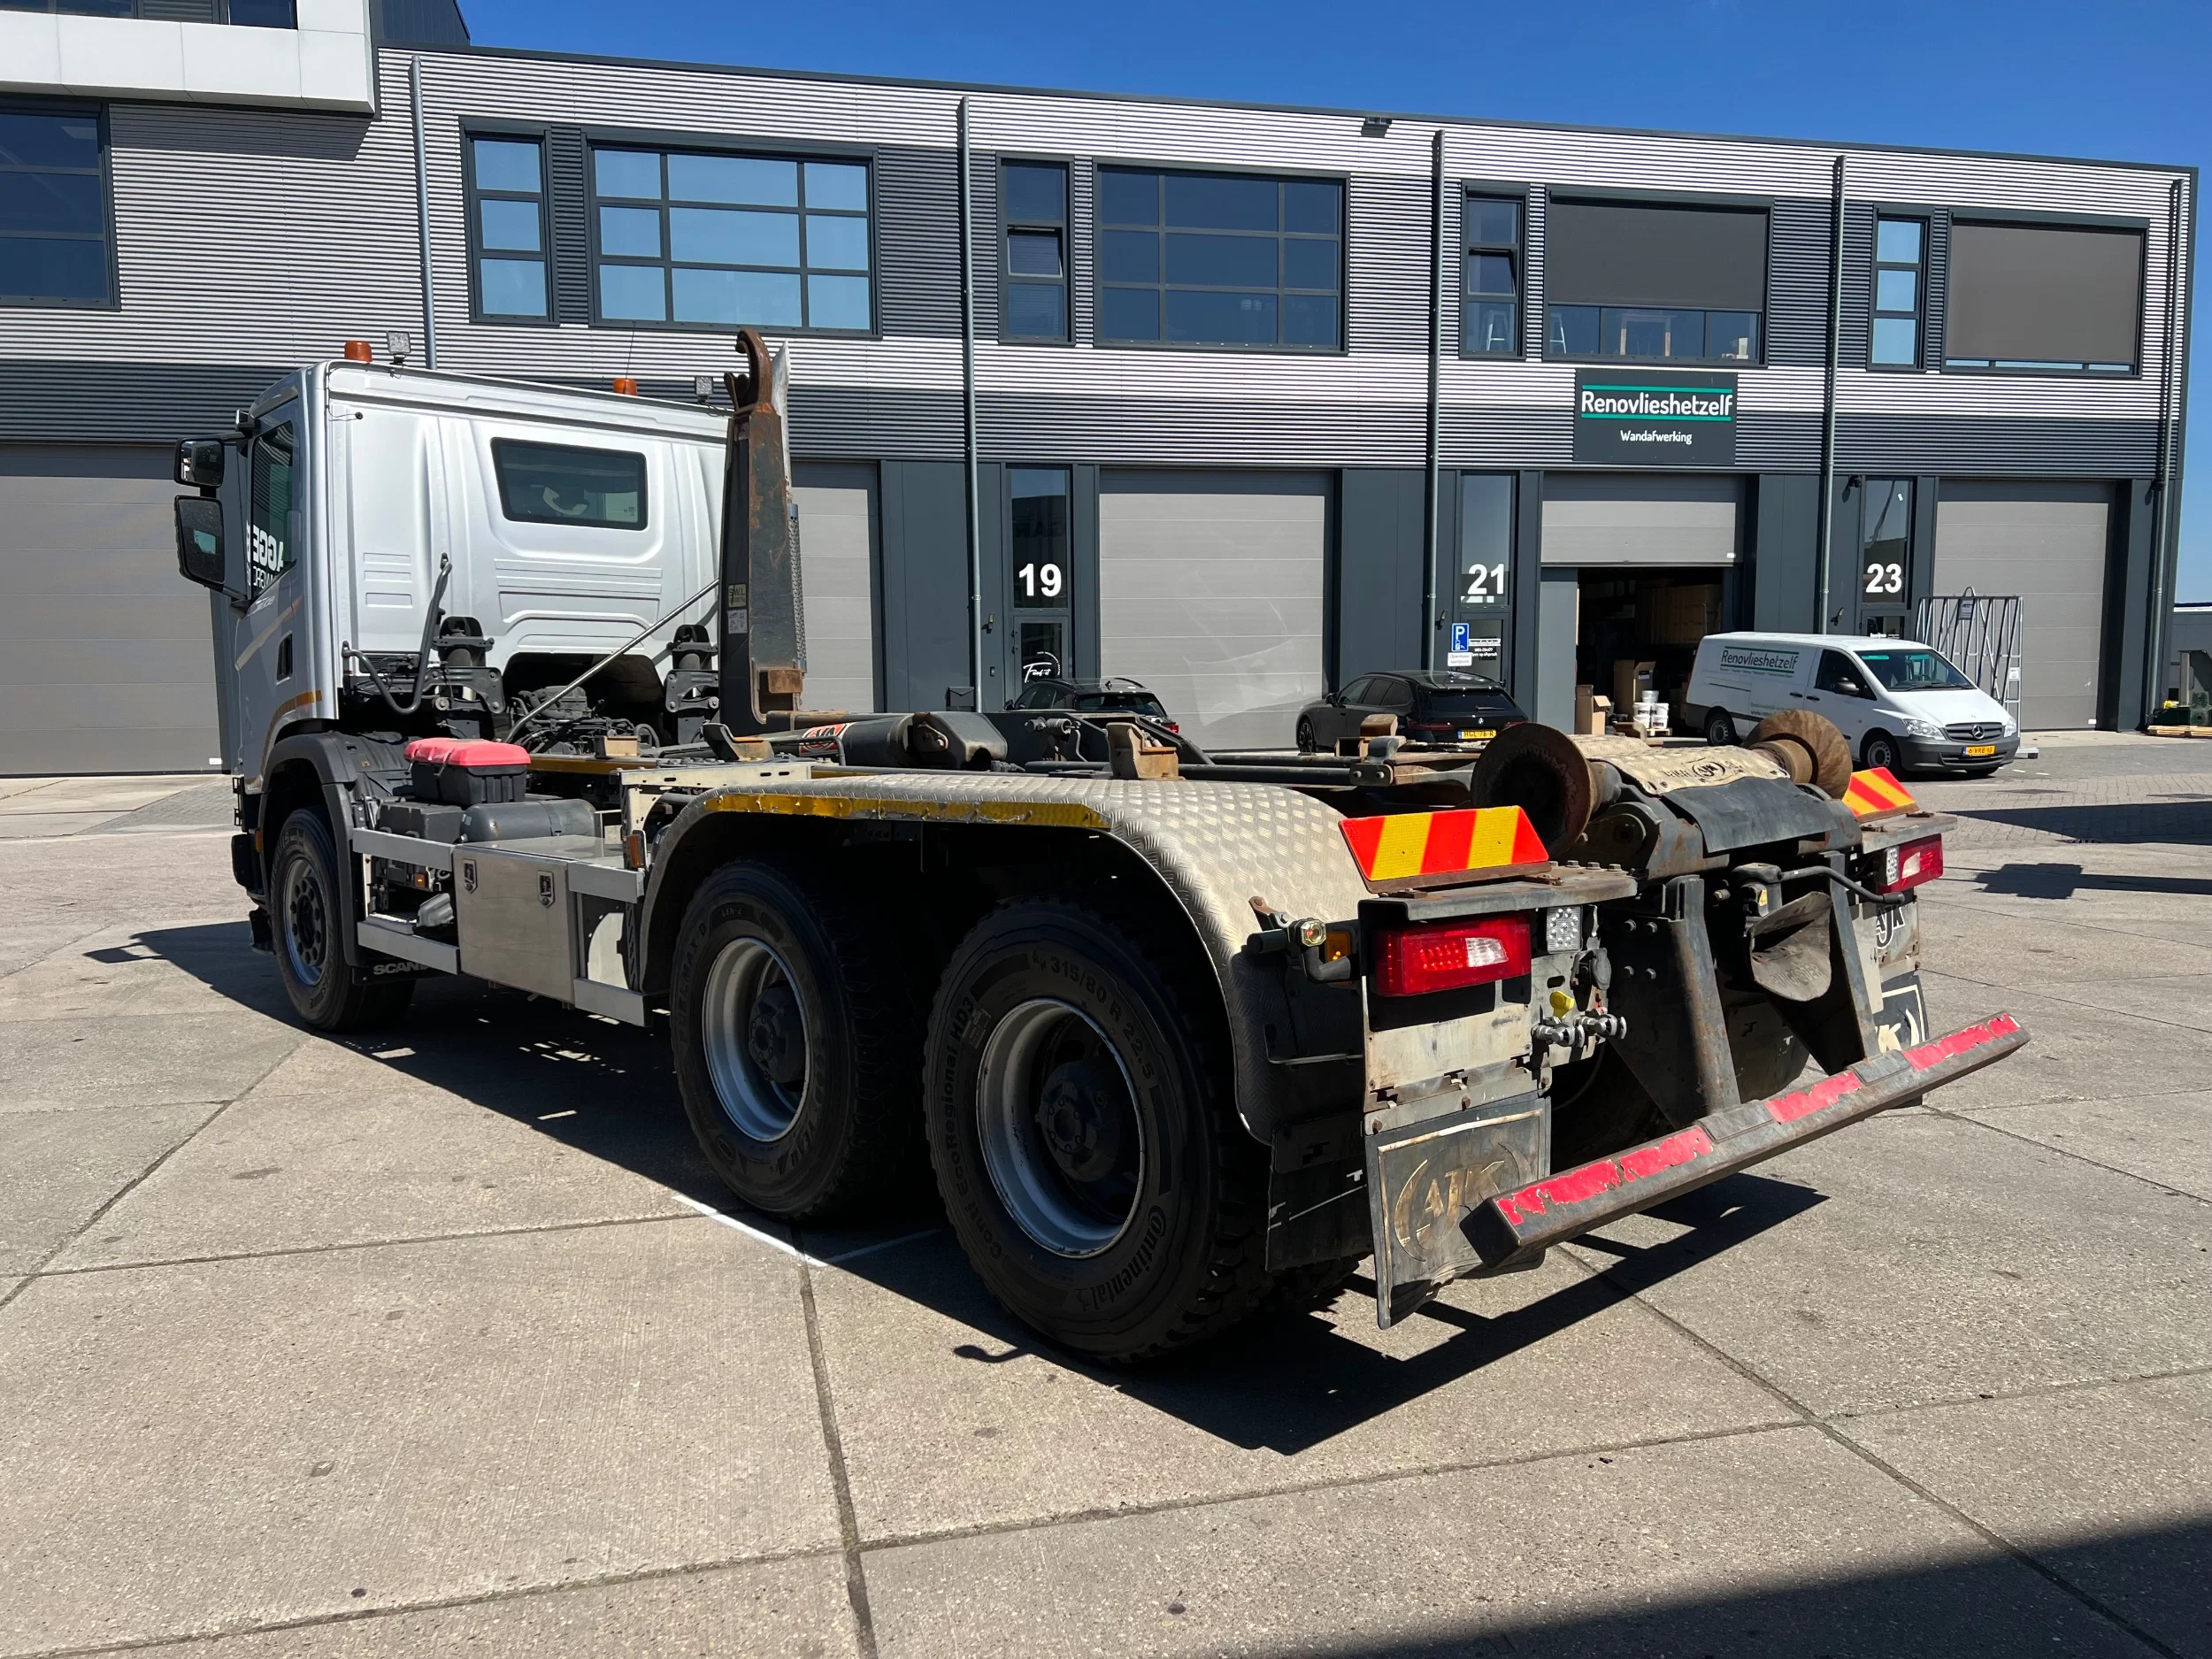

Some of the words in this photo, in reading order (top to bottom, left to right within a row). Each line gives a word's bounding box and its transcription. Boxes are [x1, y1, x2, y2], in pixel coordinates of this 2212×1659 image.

[1581, 390, 1733, 416] Renovlieshetzelf
[1619, 429, 1693, 445] Wandafwerking
[1018, 563, 1062, 597] 19
[1467, 563, 1504, 595] 21
[1865, 563, 1902, 594] 23
[1455, 626, 1465, 641] P
[1721, 649, 1799, 669] Renovlieshetzelf
